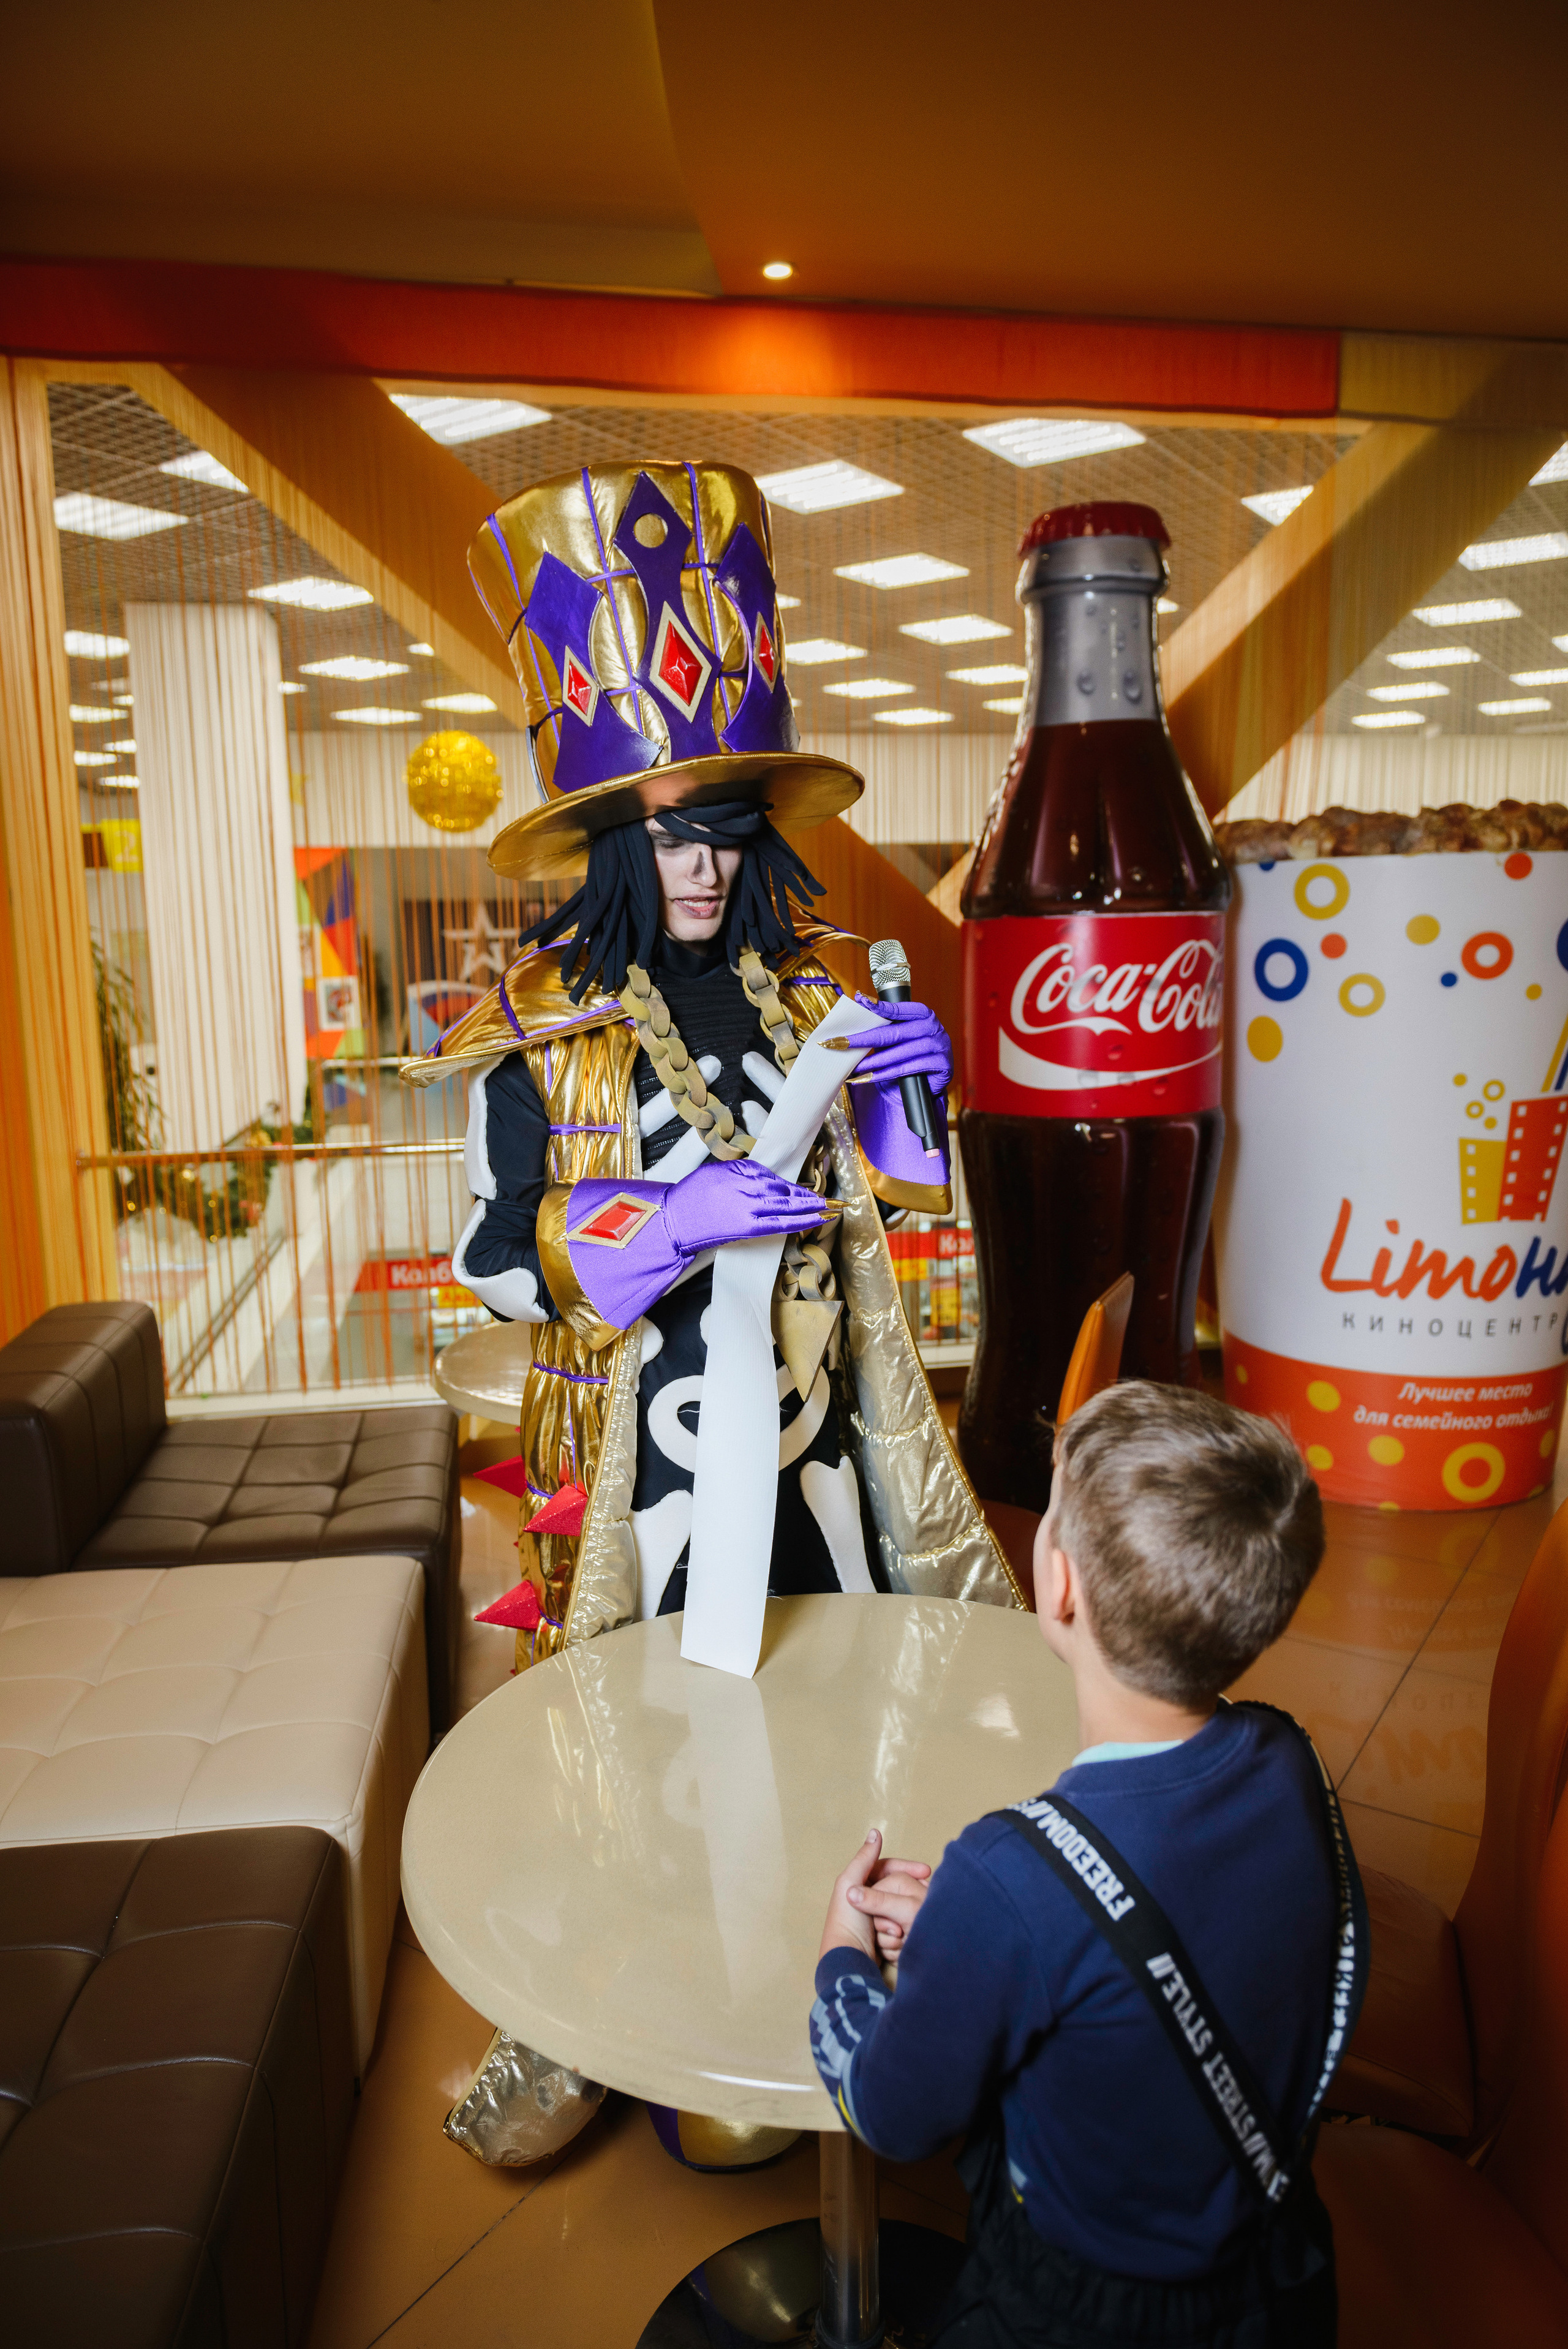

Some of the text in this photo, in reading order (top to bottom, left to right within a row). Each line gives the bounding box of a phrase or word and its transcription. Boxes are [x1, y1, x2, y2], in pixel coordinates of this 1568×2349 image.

[1011, 939, 1223, 1036] Coca-Cola
[1342, 1312, 1558, 1338] КИНОЦЕНТР
[1398, 1382, 1533, 1405] Лучшее место
[1353, 1404, 1389, 1427] для
[1392, 1411, 1493, 1430] семейного
